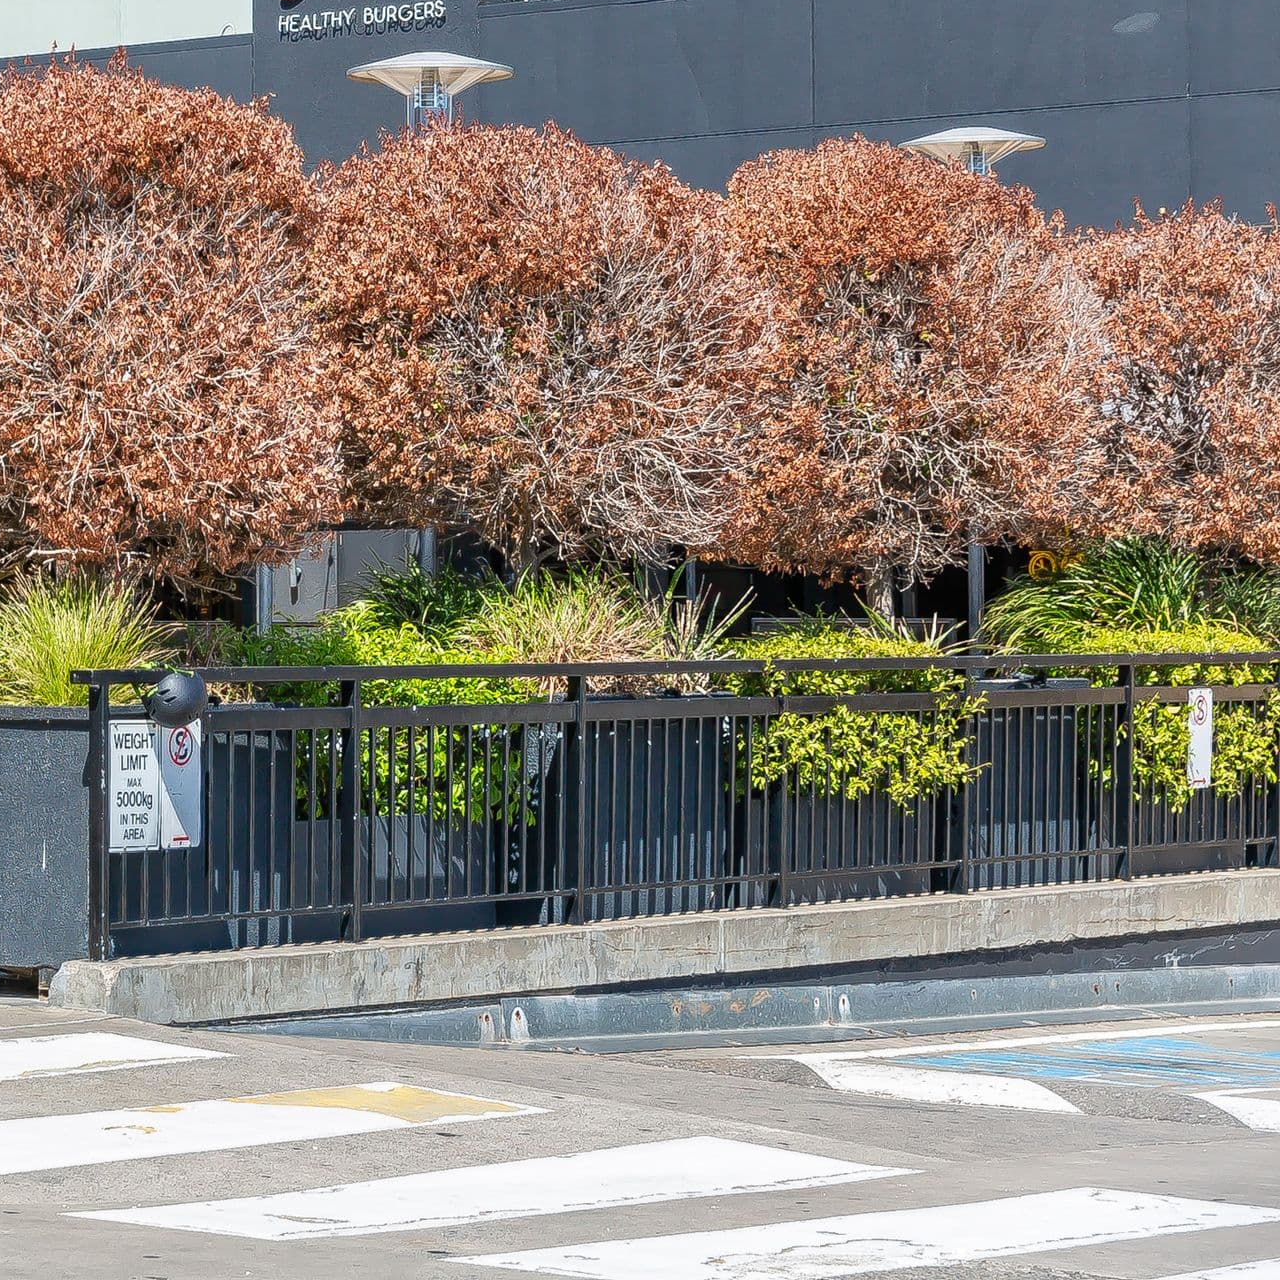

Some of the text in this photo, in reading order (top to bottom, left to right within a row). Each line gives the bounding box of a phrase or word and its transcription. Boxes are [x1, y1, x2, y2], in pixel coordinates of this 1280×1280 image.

[277, 0, 447, 33] HEALTHY BURGERS
[113, 732, 156, 750] WEIGHT
[120, 754, 148, 771] LIMIT
[126, 777, 142, 788] MAX
[116, 790, 153, 810] 5000kg
[119, 812, 149, 826] IN THIS
[123, 828, 145, 841] AREA
